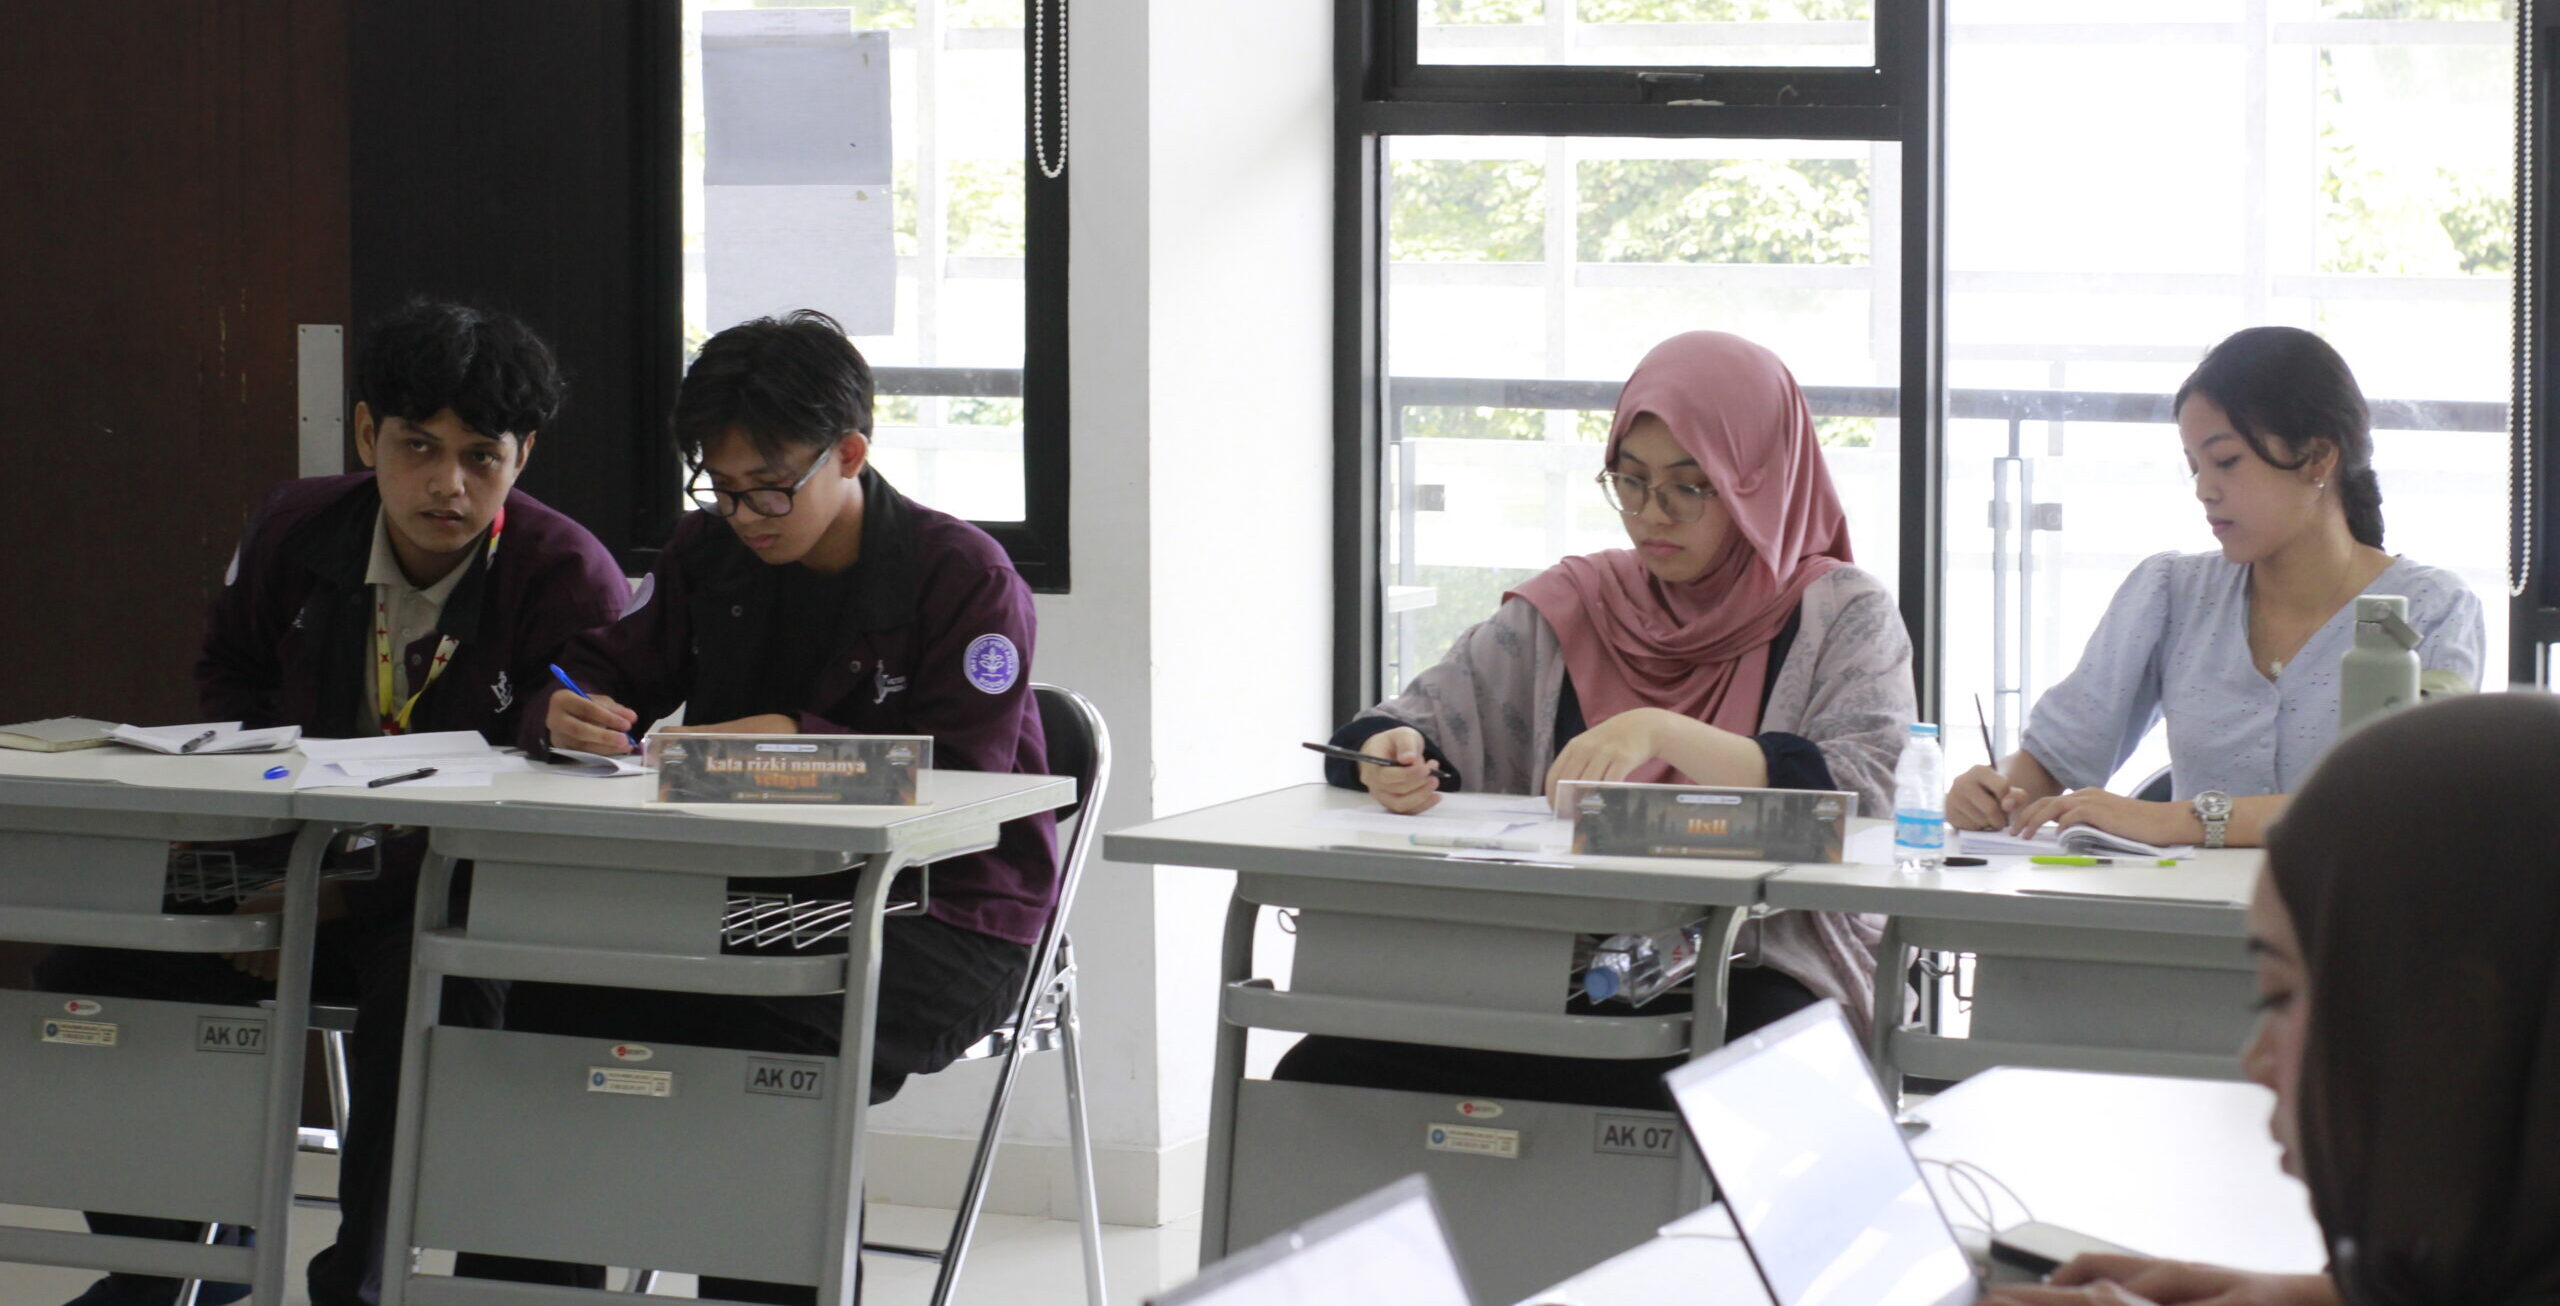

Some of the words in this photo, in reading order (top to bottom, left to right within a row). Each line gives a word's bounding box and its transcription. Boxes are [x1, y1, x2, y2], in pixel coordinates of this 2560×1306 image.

[705, 756, 743, 773] kata
[746, 756, 787, 773] rizki
[790, 759, 867, 777] namanya
[203, 1024, 232, 1046] AK
[236, 1028, 262, 1047] 07
[753, 1067, 784, 1089] AK
[790, 1070, 818, 1092] 07
[1603, 1125, 1637, 1148] AK
[1643, 1128, 1674, 1150] 07
